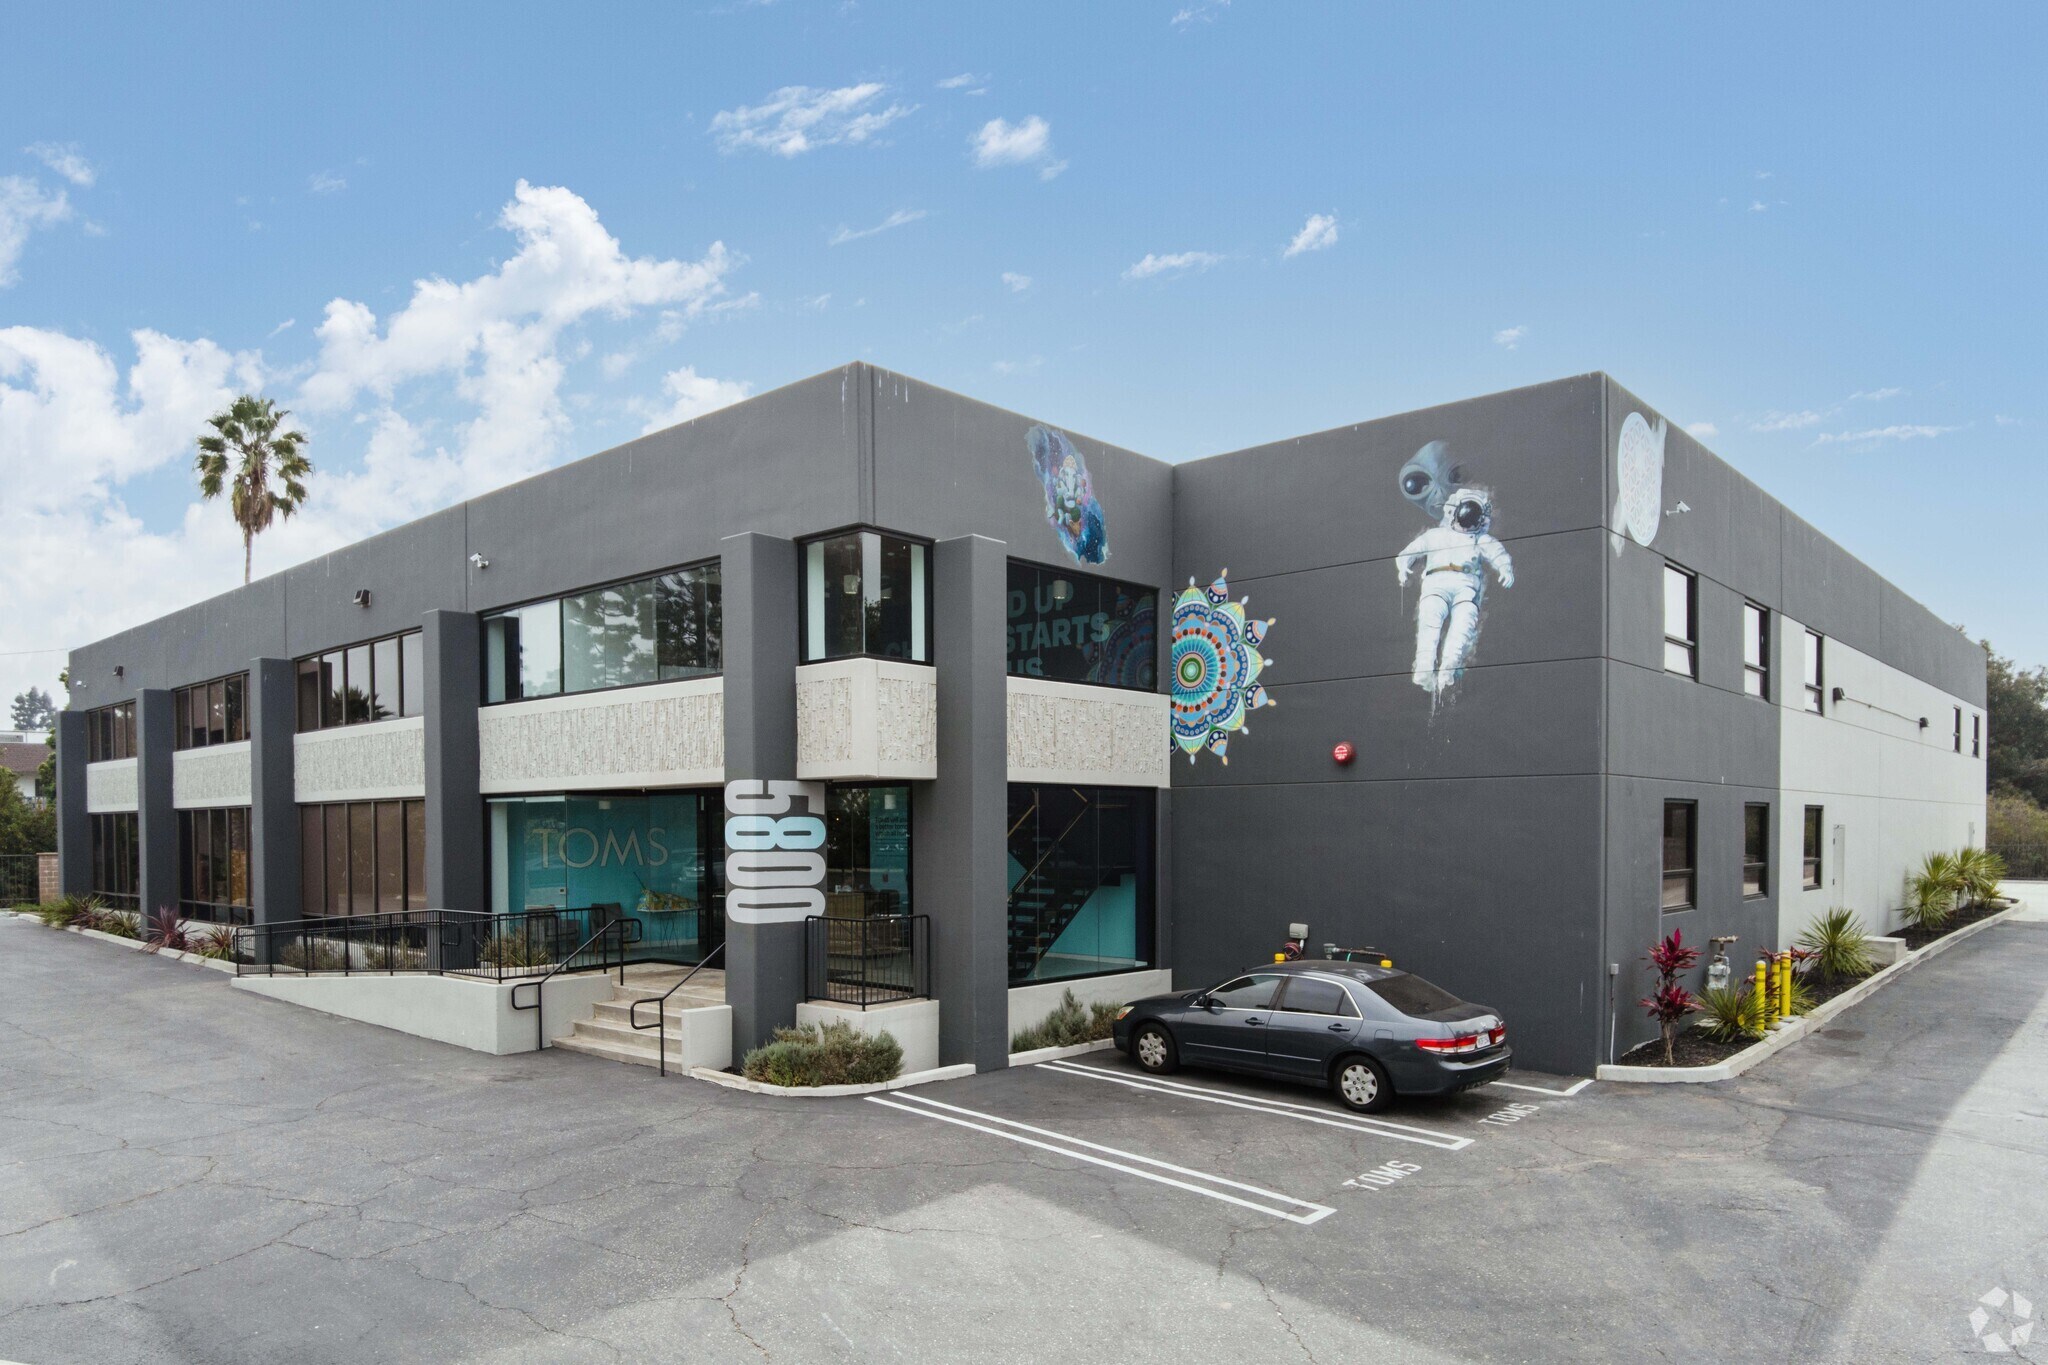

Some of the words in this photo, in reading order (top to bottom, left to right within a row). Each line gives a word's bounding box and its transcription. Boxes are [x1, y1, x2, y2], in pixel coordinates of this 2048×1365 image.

[1034, 583, 1074, 613] UP
[532, 827, 668, 868] TOMS
[725, 779, 826, 924] 5800
[1478, 1103, 1540, 1126] TOMS
[1342, 1160, 1422, 1191] TOMS
